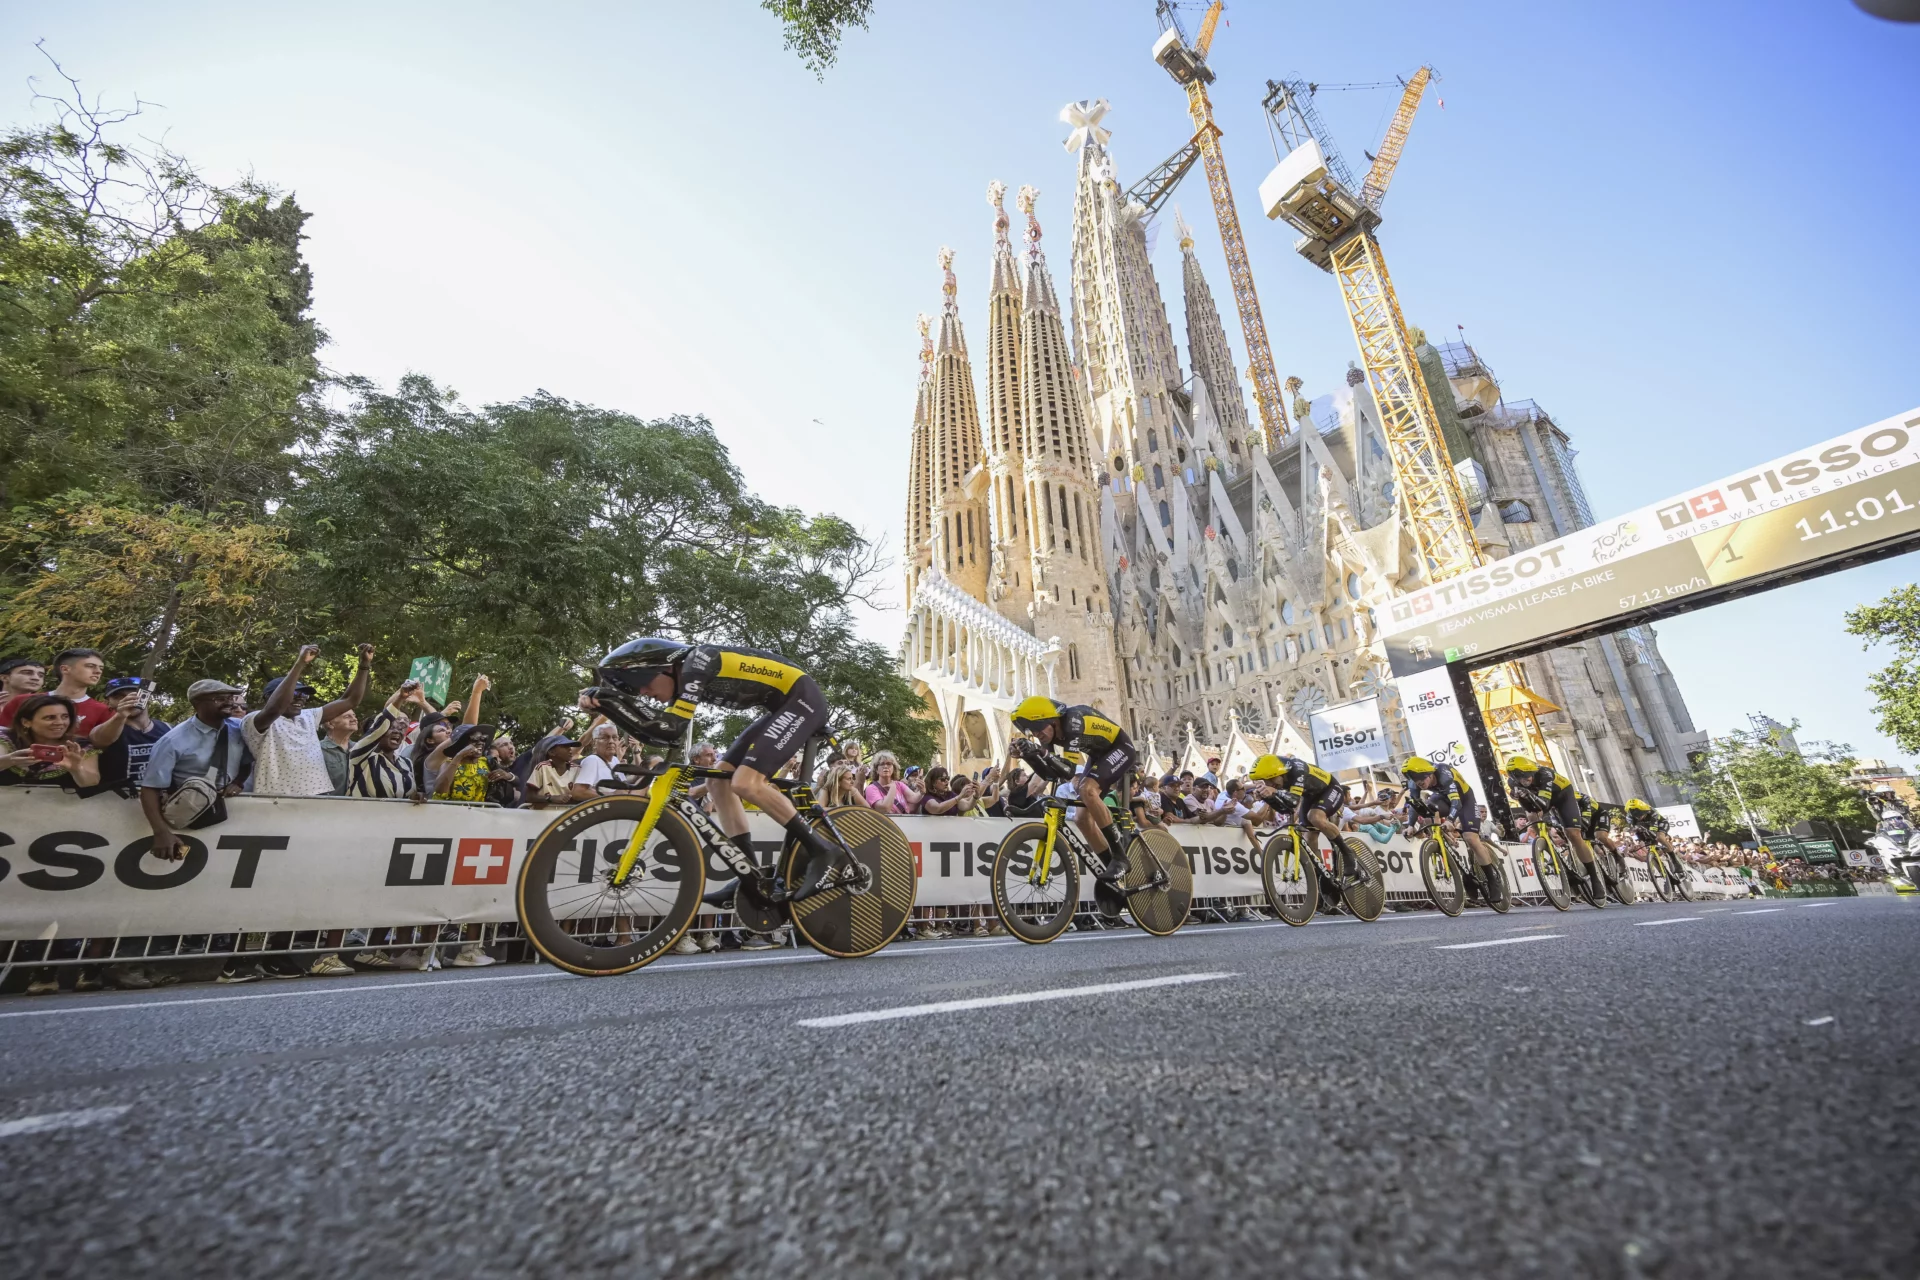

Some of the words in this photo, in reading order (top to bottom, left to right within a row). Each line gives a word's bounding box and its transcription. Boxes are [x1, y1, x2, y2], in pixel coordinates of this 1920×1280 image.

[1666, 519, 1720, 542] SWISS
[1729, 485, 1821, 521] WATCHES
[1833, 459, 1900, 487] SINCE
[1721, 542, 1744, 564] 1
[1435, 544, 1565, 605] TISSOT
[1498, 580, 1537, 599] SINCE
[1543, 567, 1575, 582] 1853
[1440, 615, 1475, 634] TEAM
[1475, 603, 1517, 622] VISMA
[1524, 586, 1568, 607] LEASE
[1570, 581, 1584, 592] A
[1583, 569, 1616, 588] BIKE
[1619, 588, 1663, 609] 57.12
[1664, 576, 1707, 596] km/h
[739, 662, 784, 680] Rabobank
[1408, 696, 1451, 713] TISSOT
[764, 711, 797, 740] VISMA
[1319, 727, 1377, 751] TISSOT
[556, 802, 610, 832] RESERVE
[0, 830, 290, 891] SOT
[1374, 850, 1414, 874] SOT
[1629, 867, 1650, 882] TISS
[630, 928, 678, 964] RESERVE
